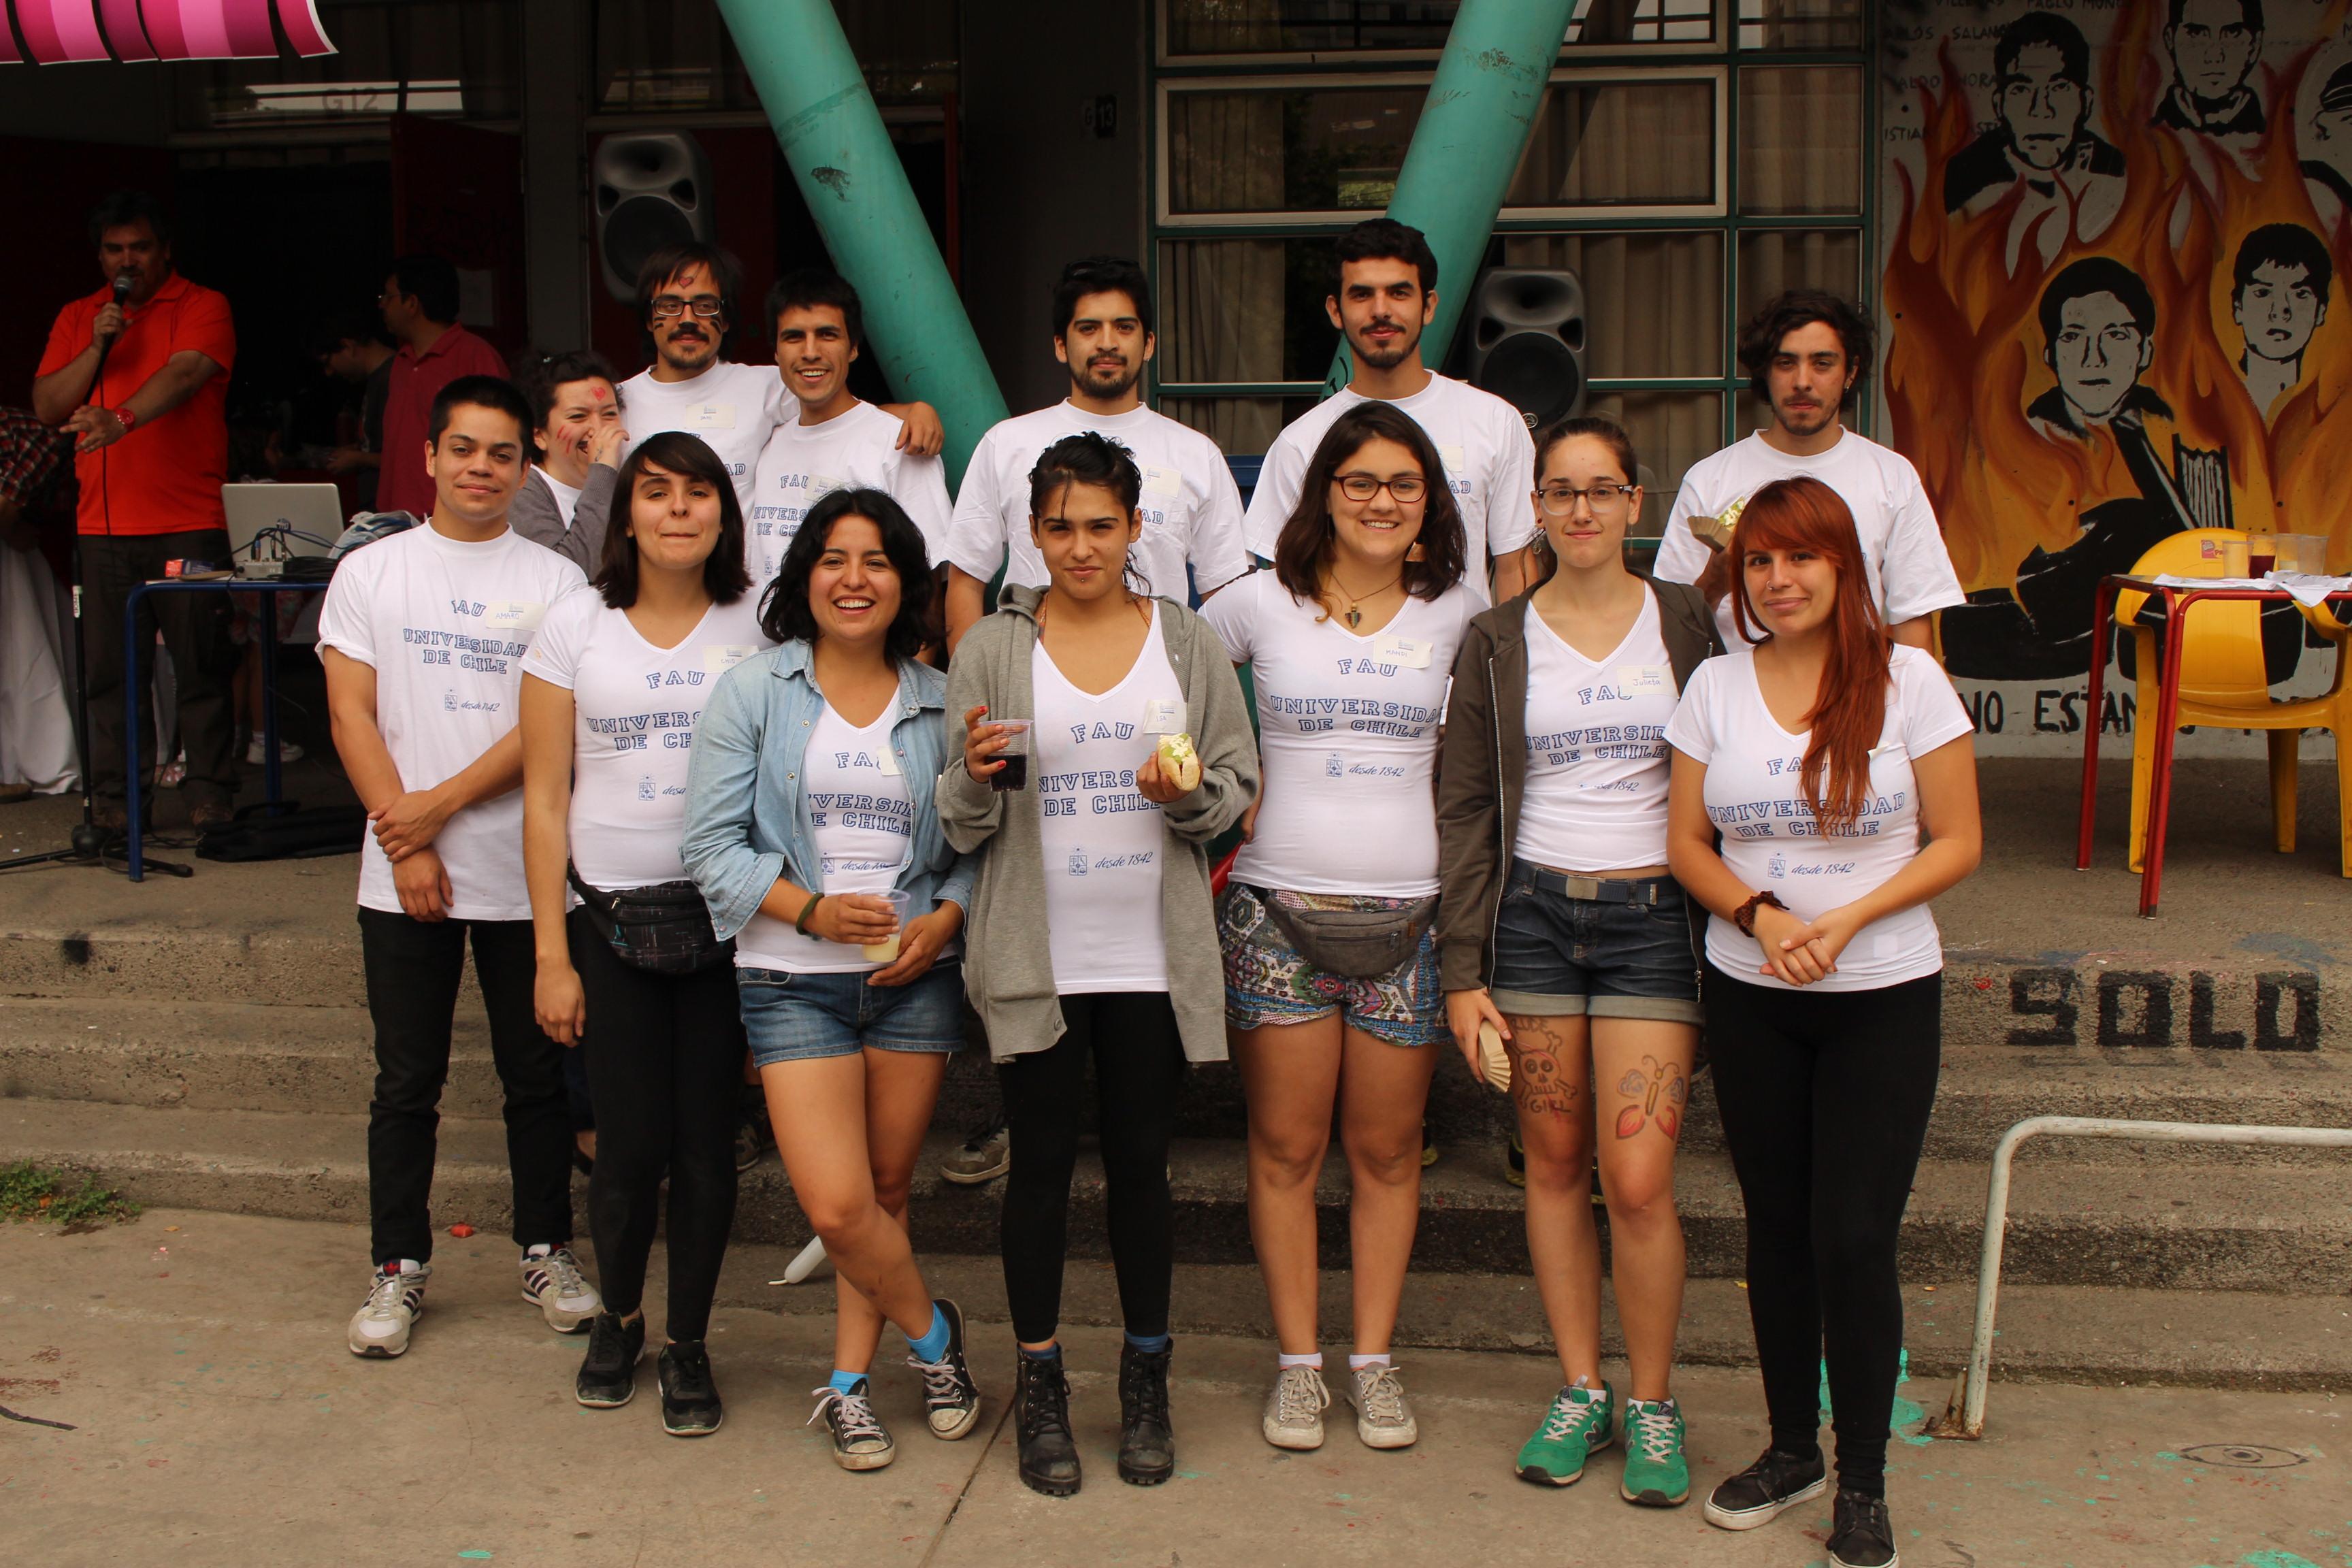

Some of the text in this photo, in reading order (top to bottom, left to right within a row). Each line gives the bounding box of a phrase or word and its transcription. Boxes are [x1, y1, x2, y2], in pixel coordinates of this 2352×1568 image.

[451, 600, 487, 617] AU
[423, 649, 451, 664] DE
[1338, 658, 1398, 677] FAU
[646, 670, 705, 689] FAU
[1071, 721, 1134, 744] FAU
[1298, 719, 1426, 738] DE CHILE
[615, 734, 647, 751] DE
[835, 751, 881, 770] FA
[1548, 745, 1668, 765] DE CHILE
[1348, 764, 1405, 777] desde 1842
[1614, 781, 1639, 791] 1842
[1045, 798, 1077, 816] DE
[1735, 823, 1774, 838] DE
[841, 860, 870, 870] desde
[1094, 851, 1154, 869] desde 1842
[1791, 862, 1855, 875] desde 1842
[2006, 968, 2320, 1051] SOLO
